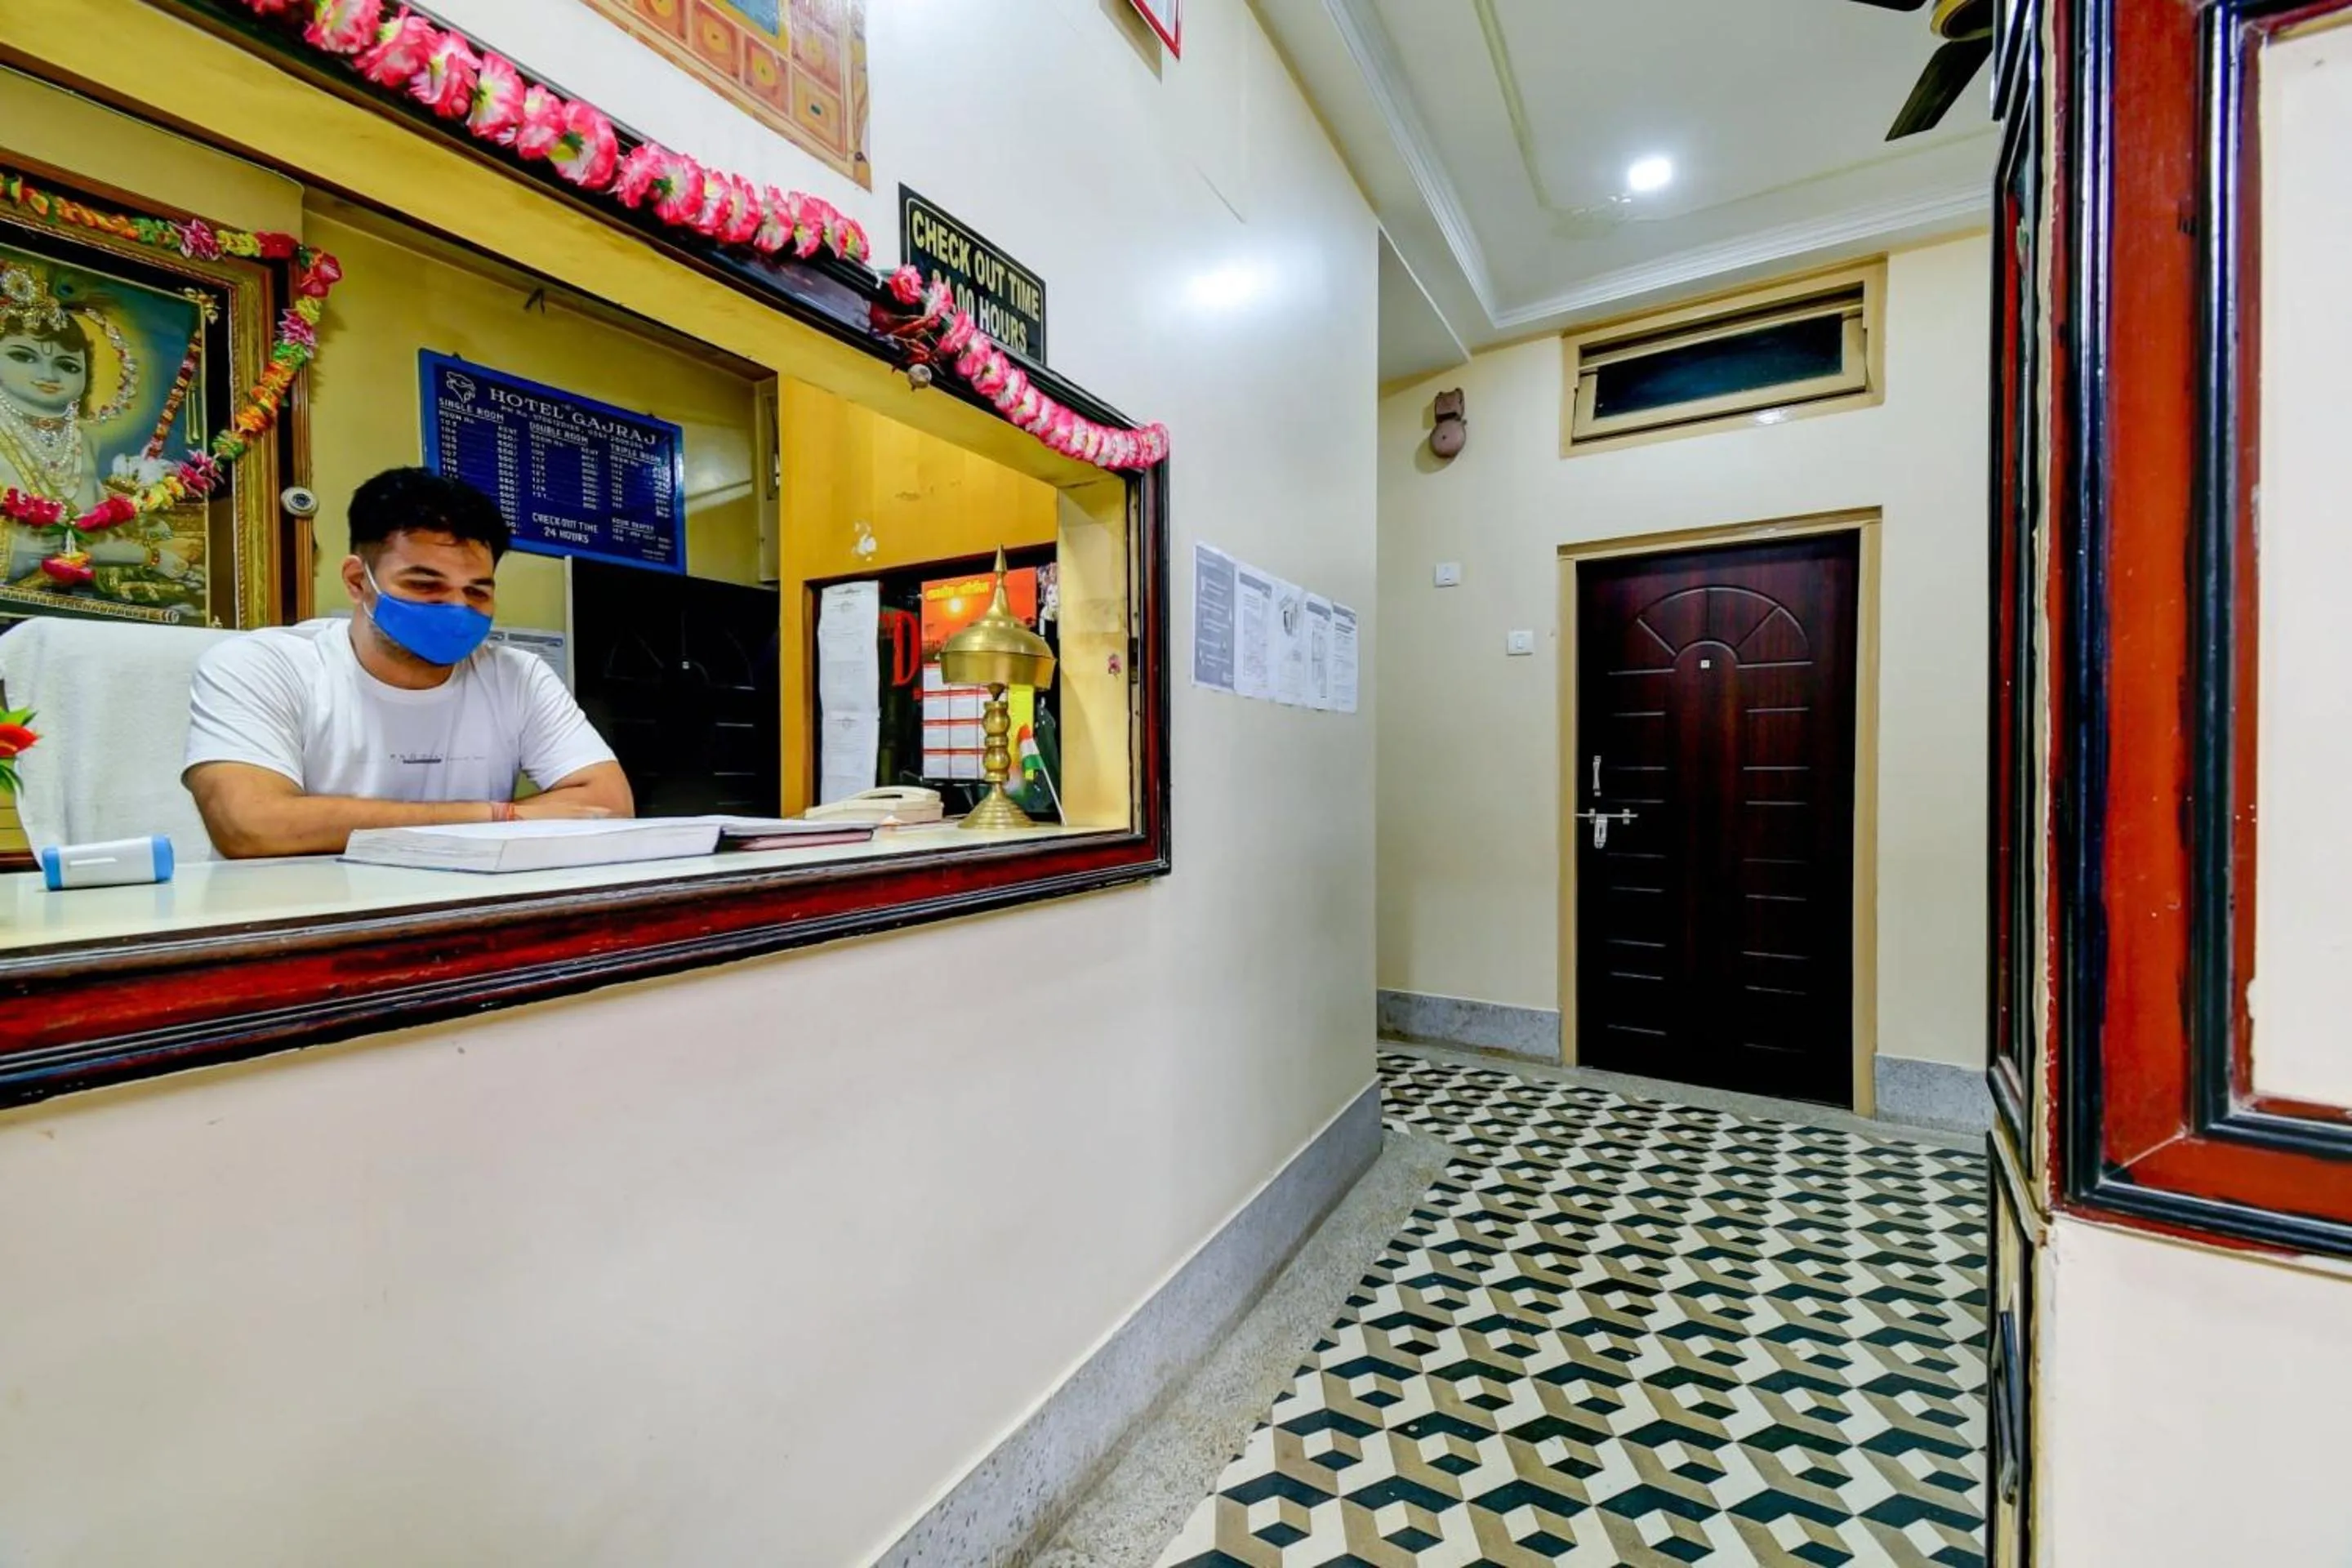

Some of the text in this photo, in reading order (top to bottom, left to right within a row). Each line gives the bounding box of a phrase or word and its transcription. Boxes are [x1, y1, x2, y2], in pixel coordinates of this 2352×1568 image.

[911, 210, 1040, 323] CHECK OUT TIME
[979, 295, 1028, 354] HOURS
[439, 396, 504, 422] SINGLE ROOM
[489, 387, 564, 420] HOTEL
[572, 412, 657, 445] GAJRAJ
[543, 526, 590, 544] 24 HOURS
